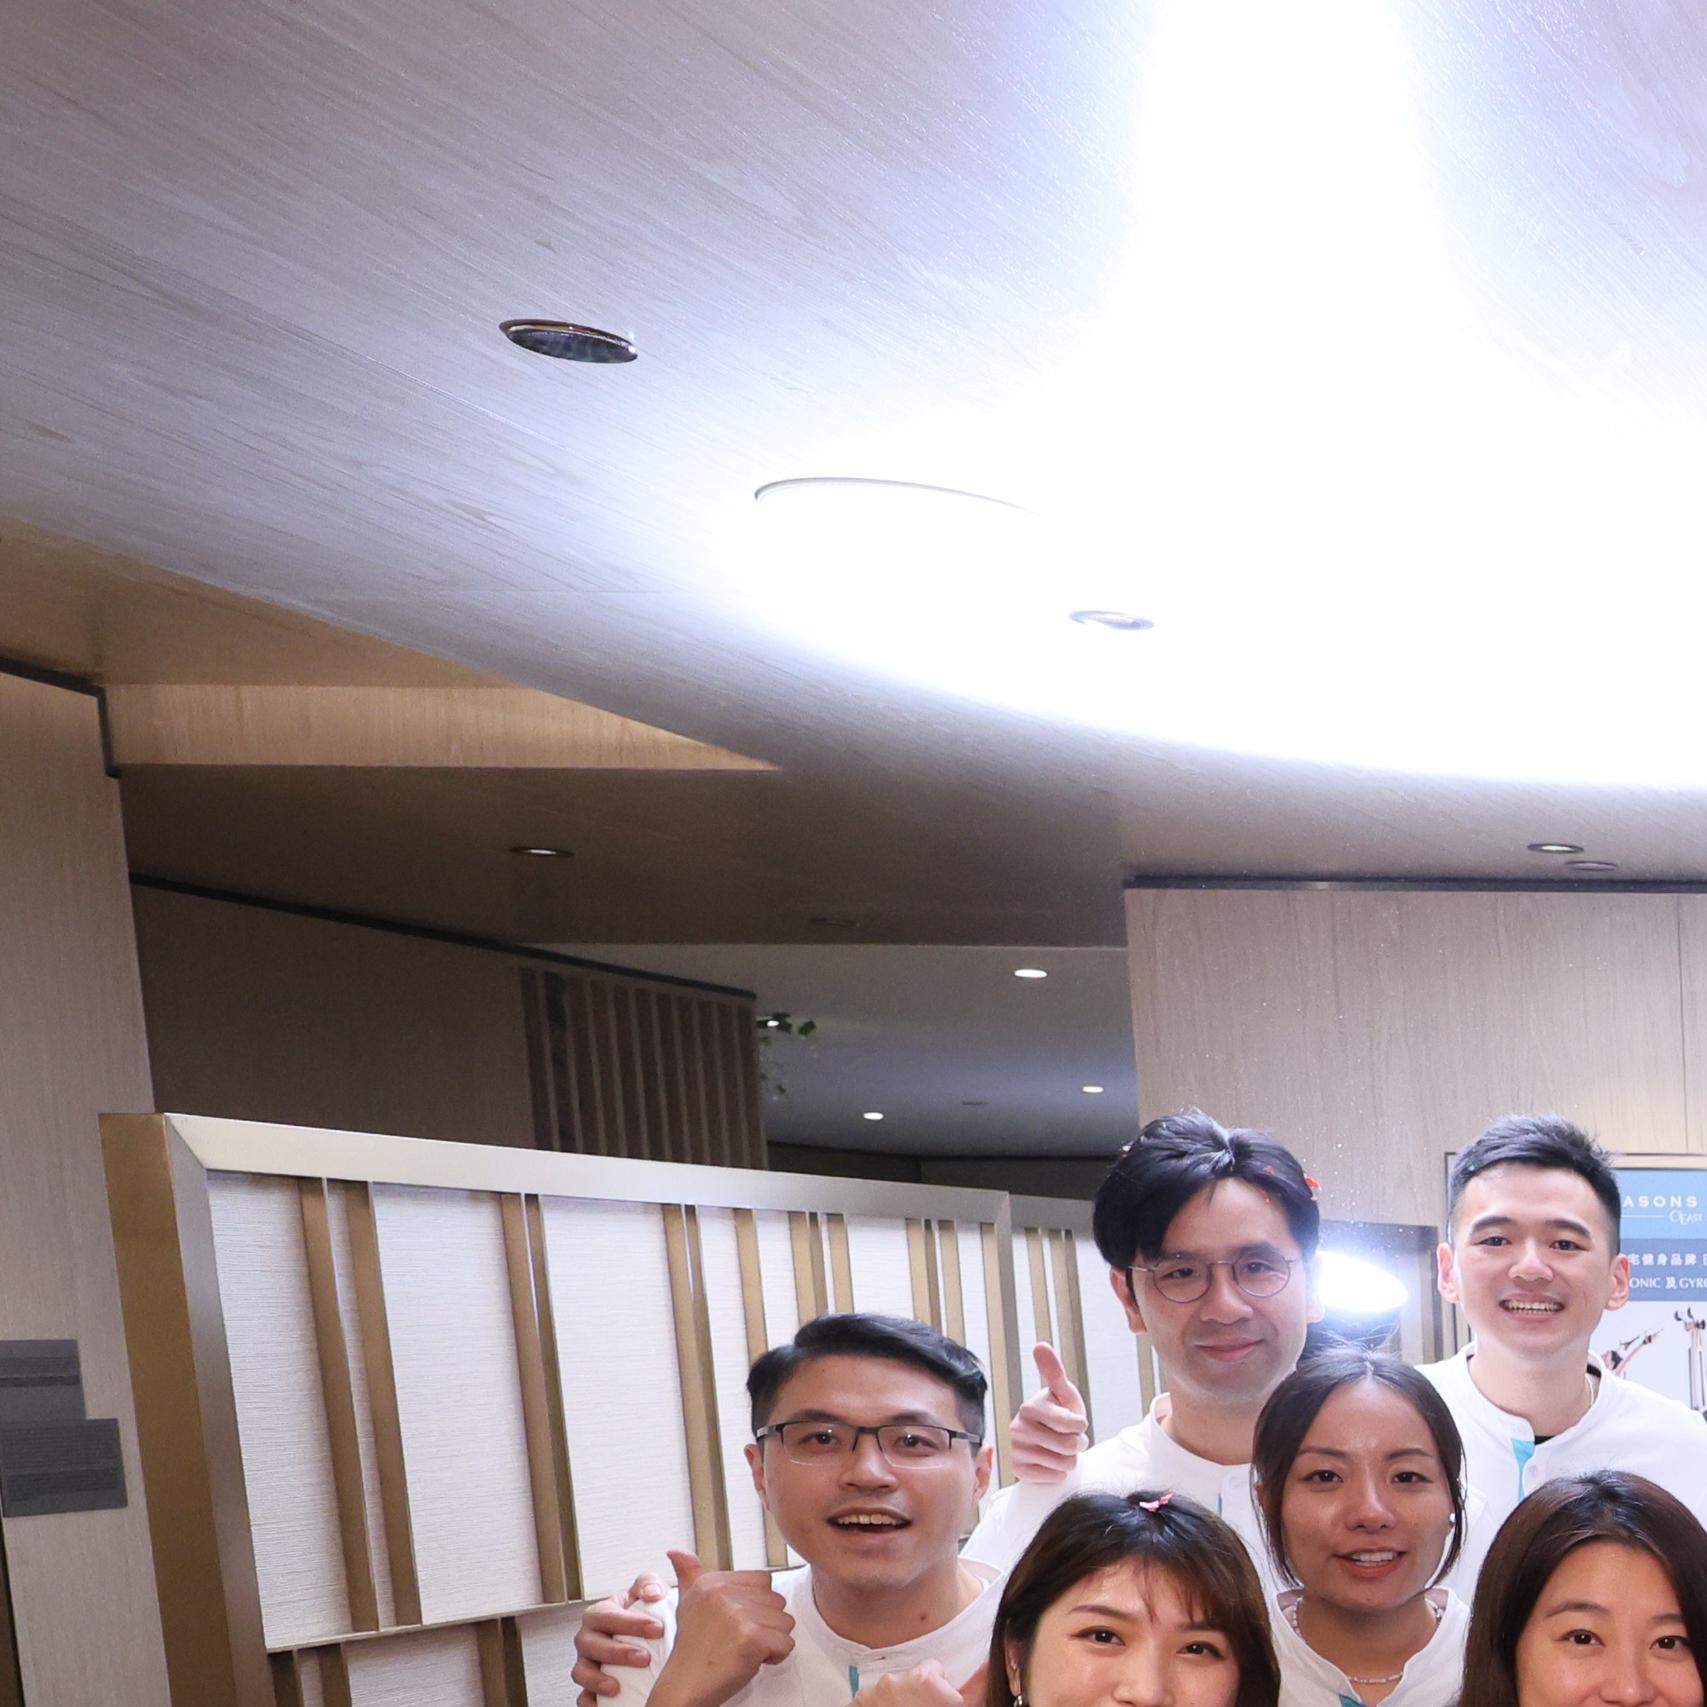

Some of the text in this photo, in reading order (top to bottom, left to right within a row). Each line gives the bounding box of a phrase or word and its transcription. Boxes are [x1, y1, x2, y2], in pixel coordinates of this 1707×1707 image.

[1623, 1196, 1697, 1208] ASONS
[1629, 1277, 1661, 1289] ONIC
[1665, 1276, 1677, 1289] 及
